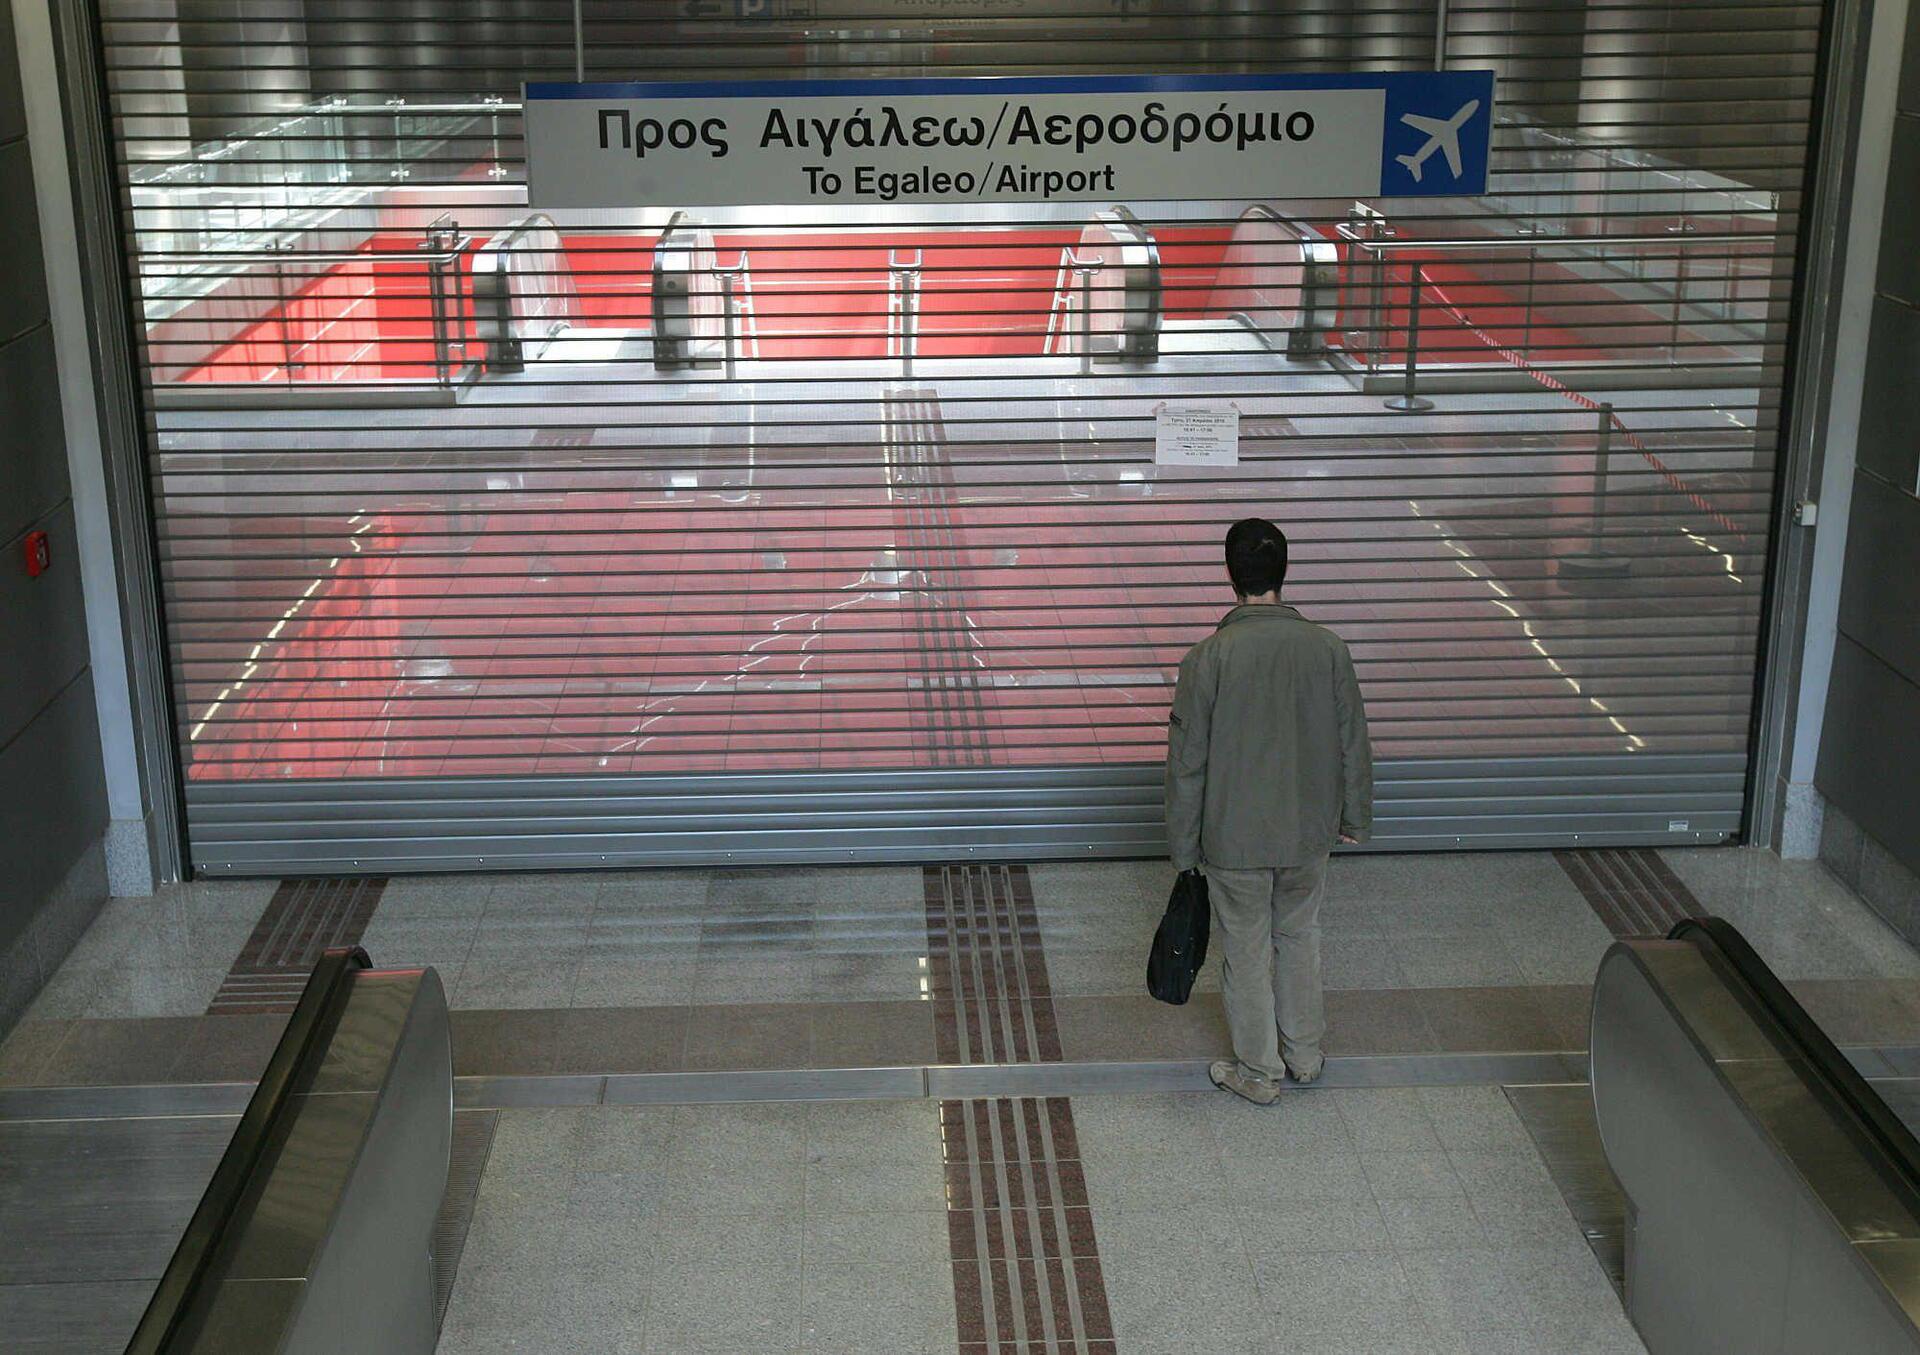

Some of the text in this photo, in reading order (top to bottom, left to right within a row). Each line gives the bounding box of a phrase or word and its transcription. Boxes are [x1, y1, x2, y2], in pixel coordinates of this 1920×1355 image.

[597, 101, 1315, 159] Προς Αιγάλεω/Αεροδρόμιο
[801, 162, 1116, 202] To Egaleo/Airport
